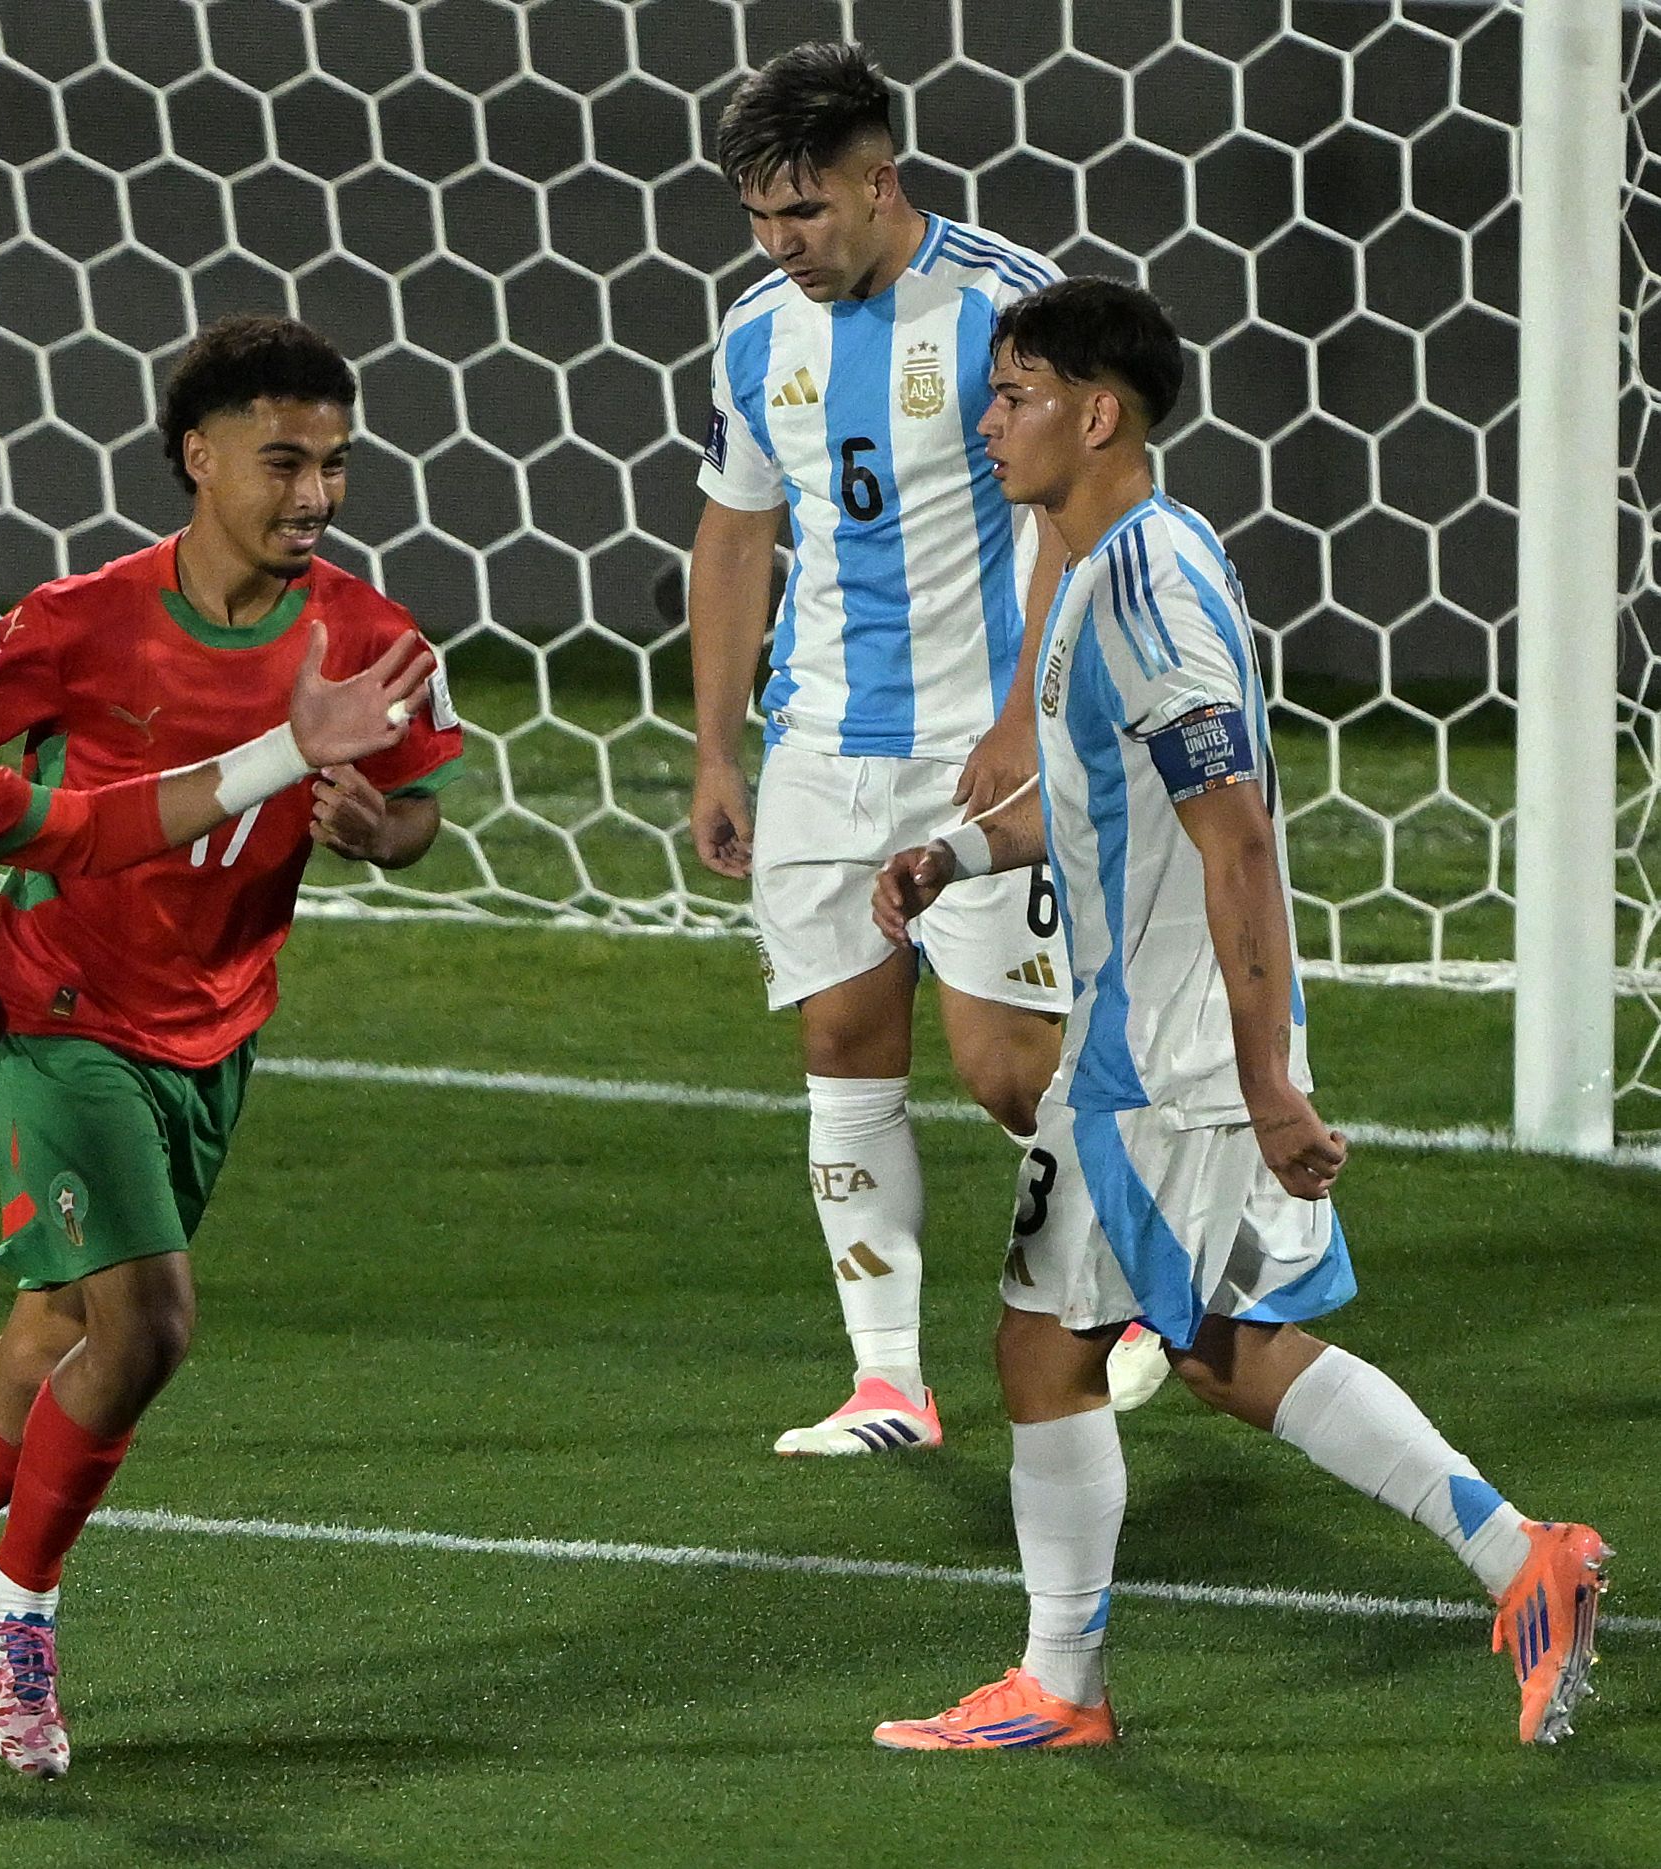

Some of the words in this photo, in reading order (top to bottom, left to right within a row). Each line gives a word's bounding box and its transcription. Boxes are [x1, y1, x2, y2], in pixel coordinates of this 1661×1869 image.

[910, 373, 937, 402] AFA
[840, 437, 884, 522] 6
[1181, 717, 1224, 738] FOOTBALL
[1184, 728, 1229, 754] UNITES
[1205, 743, 1235, 763] World
[1027, 860, 1059, 938] 6
